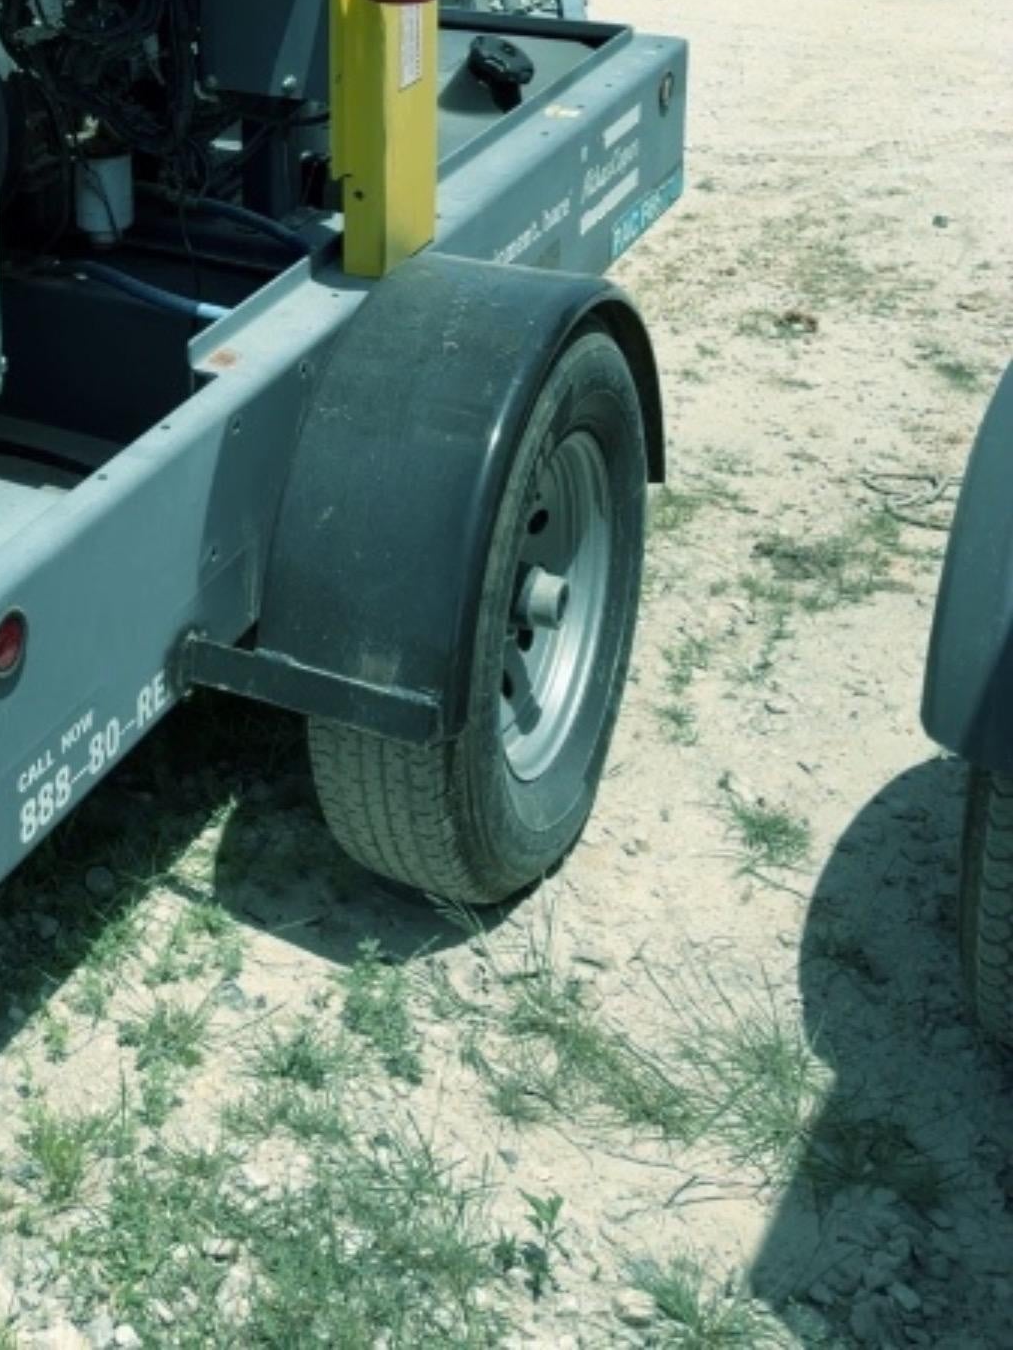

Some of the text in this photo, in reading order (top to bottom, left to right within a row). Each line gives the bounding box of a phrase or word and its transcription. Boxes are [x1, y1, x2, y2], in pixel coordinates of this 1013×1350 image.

[17, 708, 95, 794] CALL NOW
[20, 667, 170, 844] 888-80-RE
